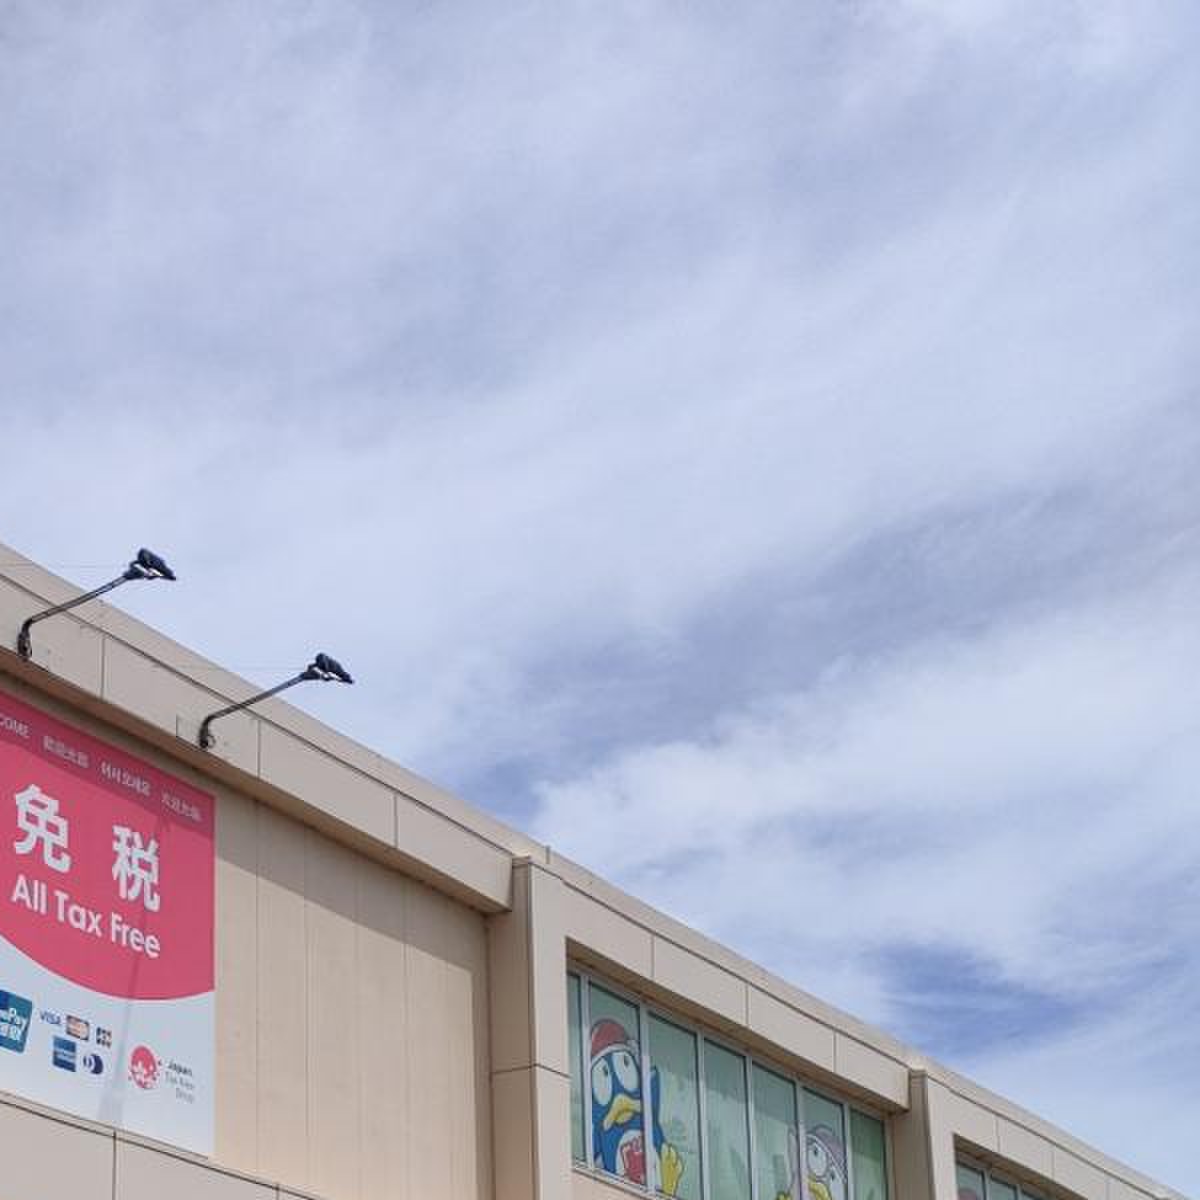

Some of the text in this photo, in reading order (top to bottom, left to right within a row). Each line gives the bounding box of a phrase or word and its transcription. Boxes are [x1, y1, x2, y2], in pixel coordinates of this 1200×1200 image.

[11, 874, 161, 958] All Tax Free
